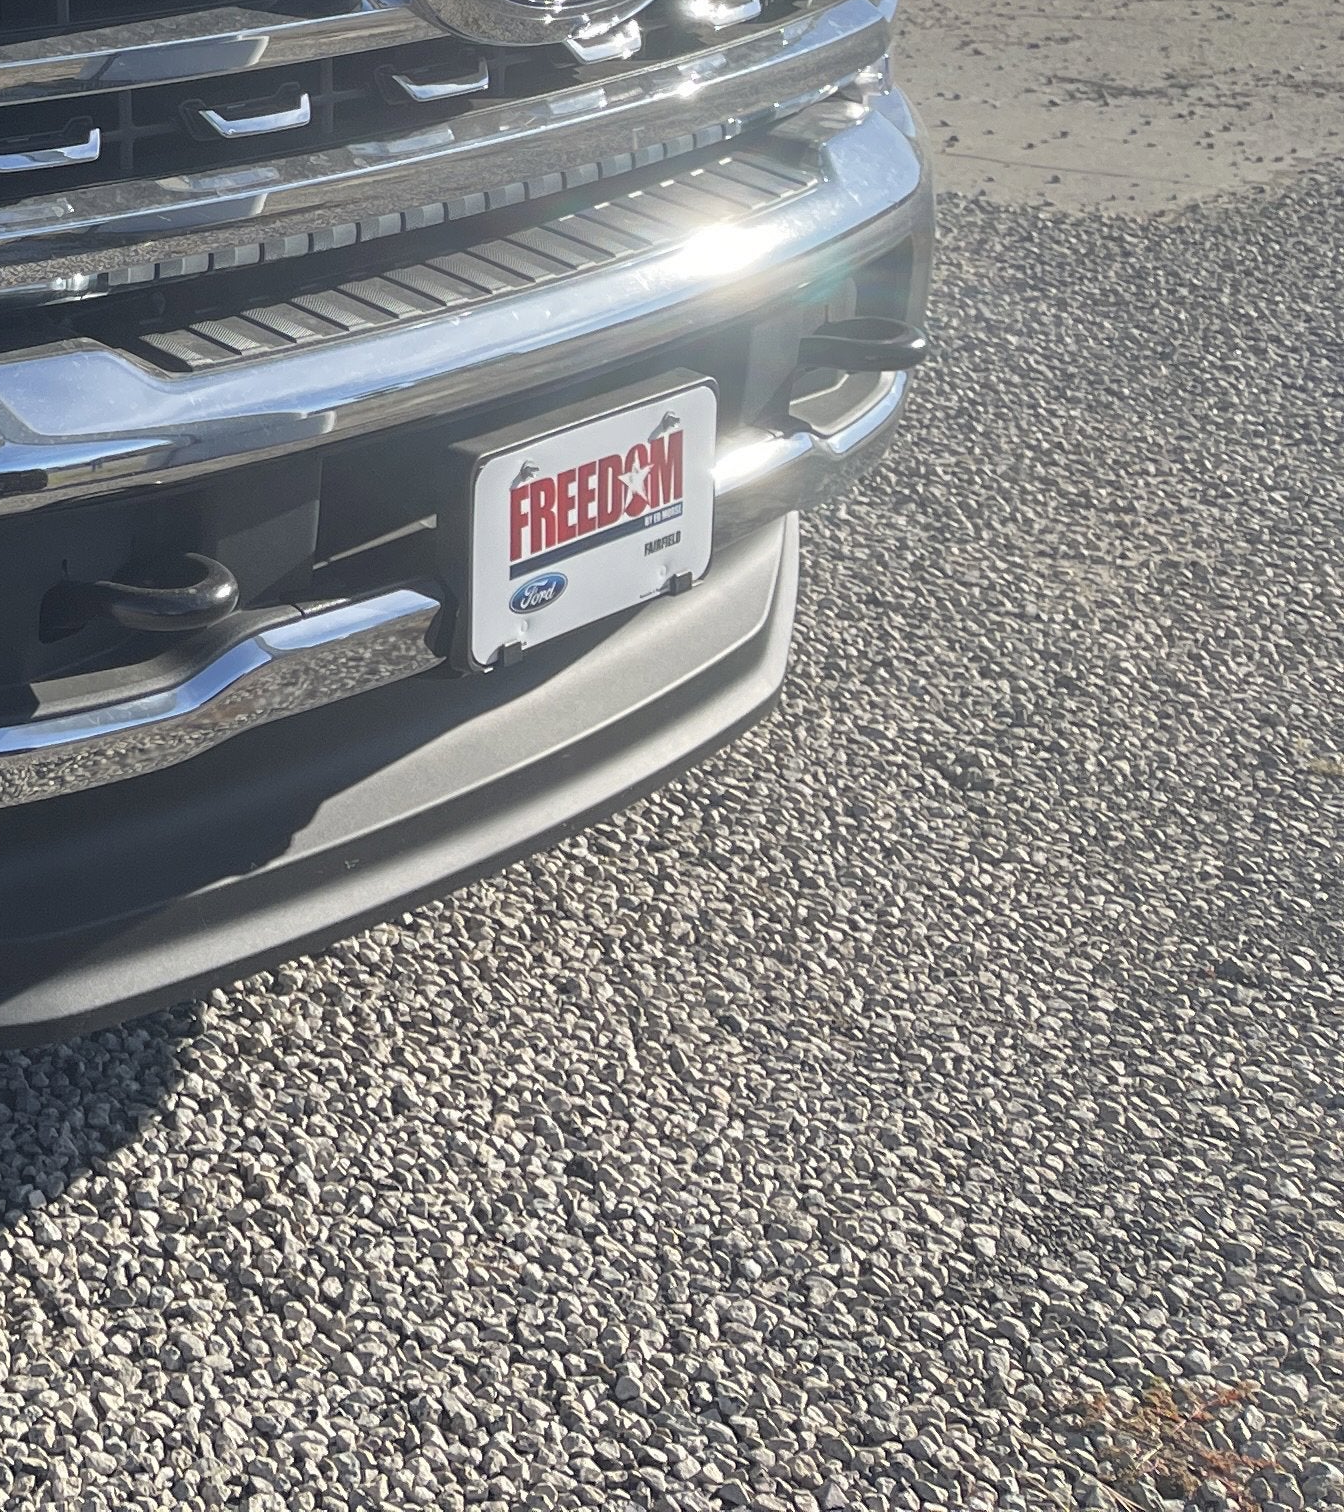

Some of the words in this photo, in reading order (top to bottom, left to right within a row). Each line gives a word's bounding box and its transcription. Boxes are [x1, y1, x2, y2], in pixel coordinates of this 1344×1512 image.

[509, 429, 684, 562] FREEDOM
[644, 530, 682, 557] FAIRFIELD
[520, 579, 556, 609] Ford
